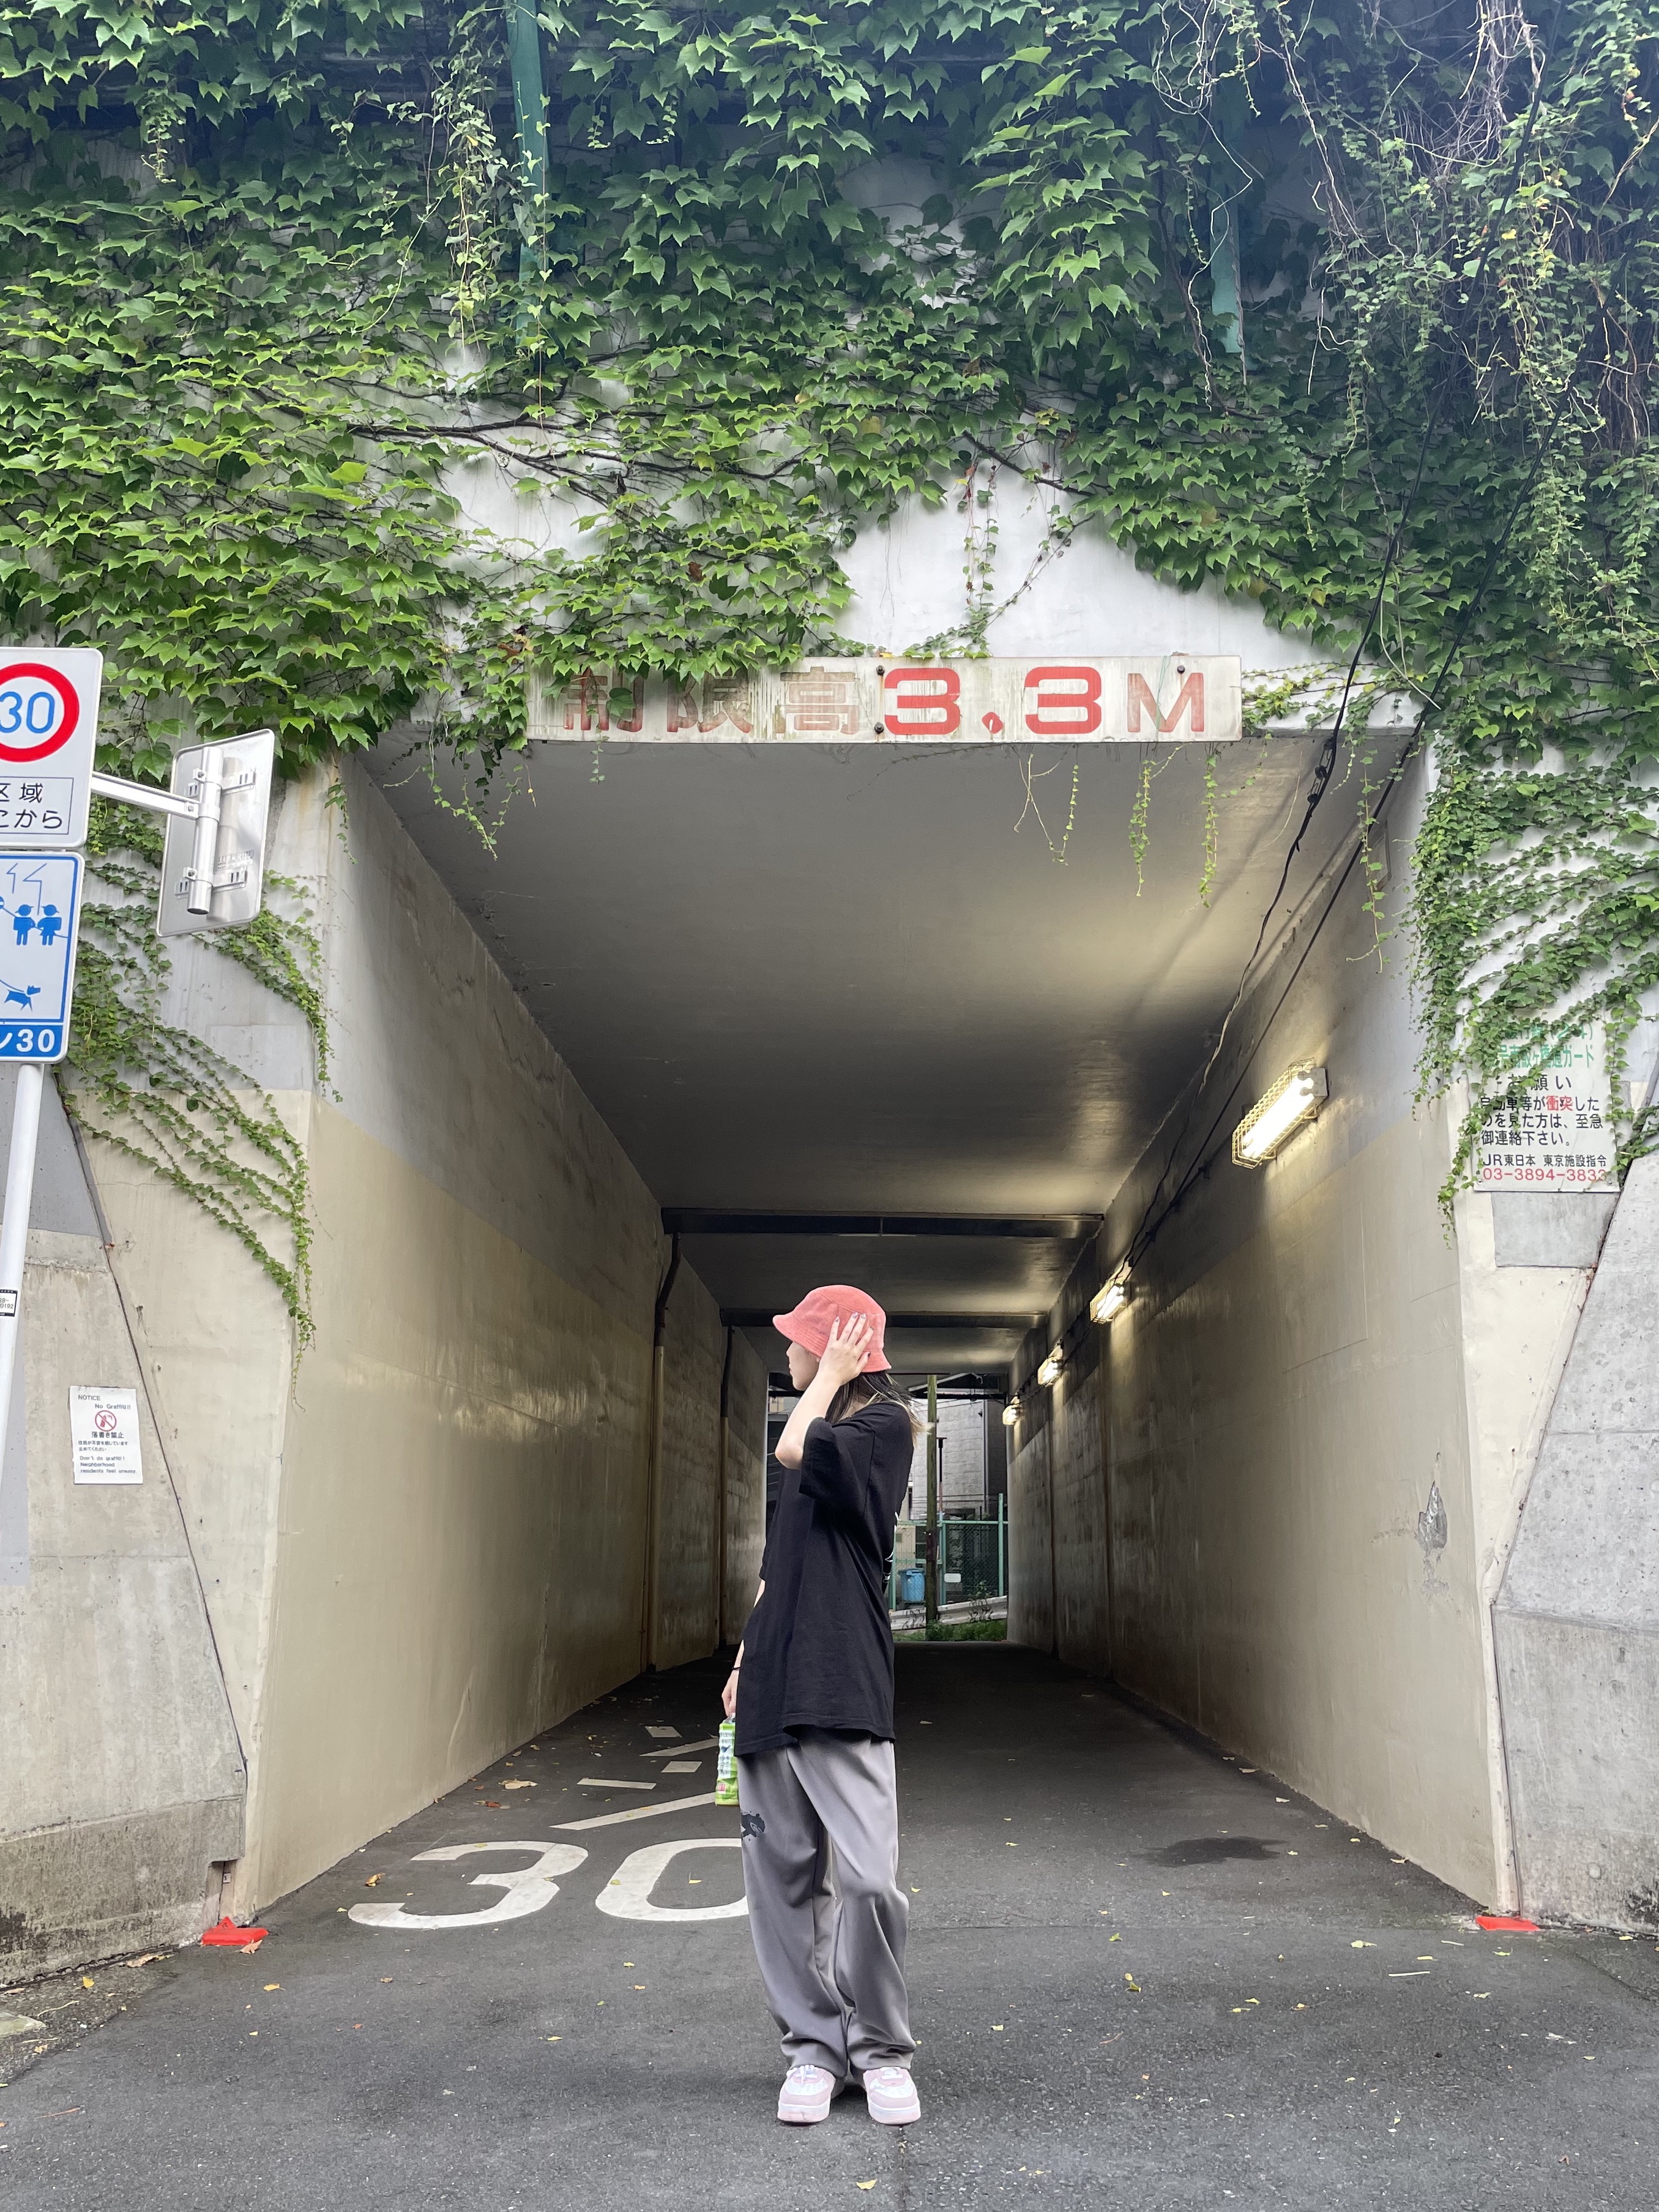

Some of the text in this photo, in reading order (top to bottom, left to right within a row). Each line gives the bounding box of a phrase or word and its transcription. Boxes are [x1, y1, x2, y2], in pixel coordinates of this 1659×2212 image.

[0, 691, 55, 734] 30
[1481, 1130, 1570, 1146] 御連絡下さい。
[1483, 1154, 1607, 1167] JR東日本 東京施設指令
[348, 1838, 749, 1930] 30
